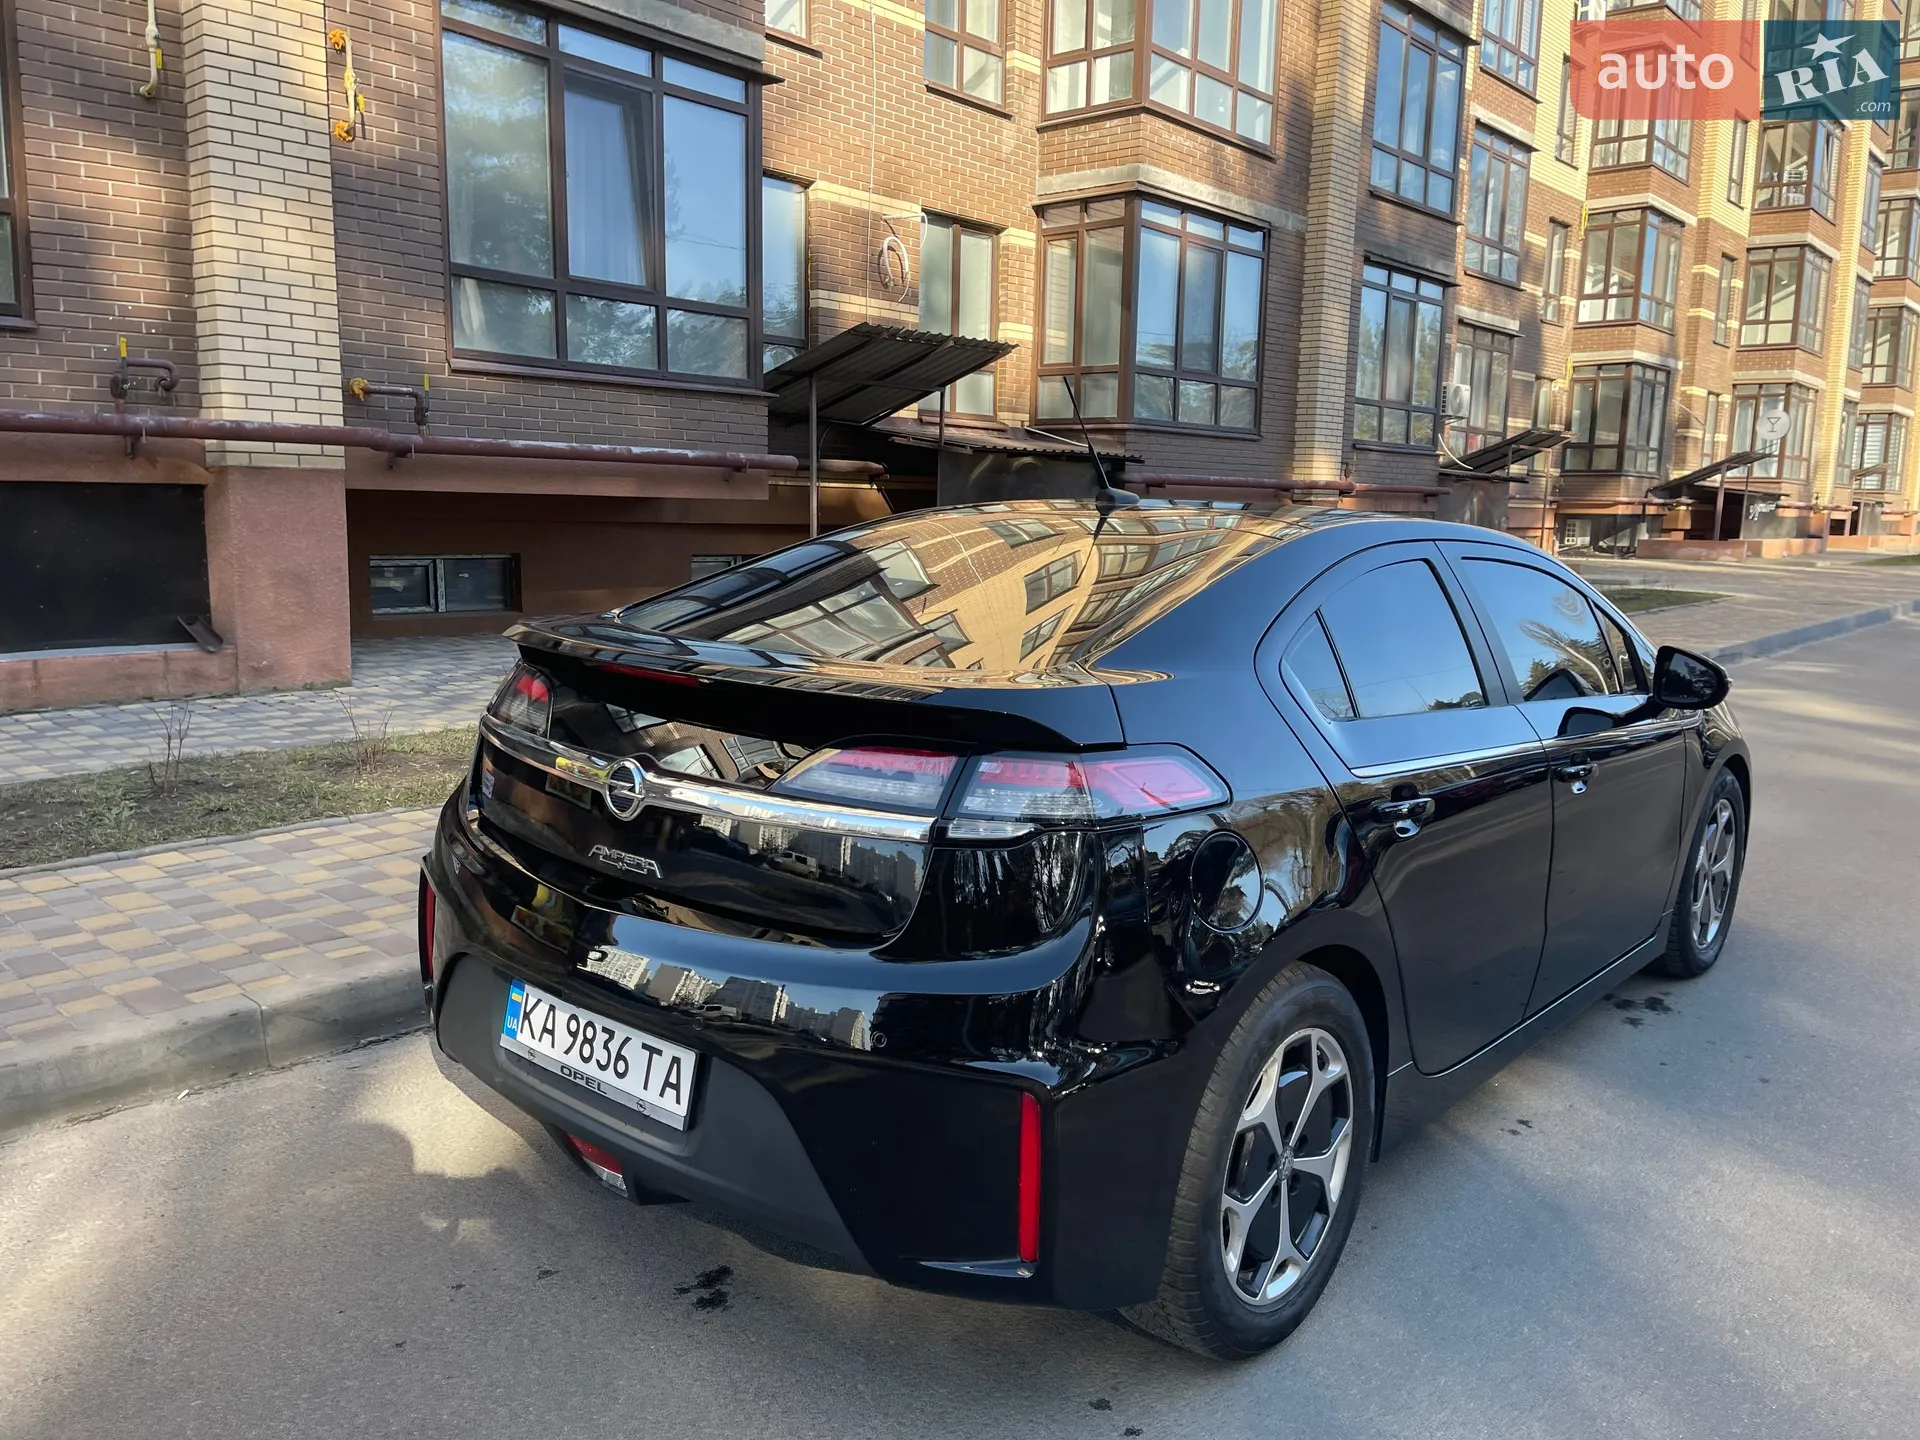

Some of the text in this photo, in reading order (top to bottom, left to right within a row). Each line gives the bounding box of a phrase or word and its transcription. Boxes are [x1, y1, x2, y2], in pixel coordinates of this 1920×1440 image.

[588, 844, 664, 879] AMPERA
[507, 1015, 518, 1032] UA
[520, 993, 681, 1105] KA 9836 TA
[560, 1065, 608, 1095] OPEL
